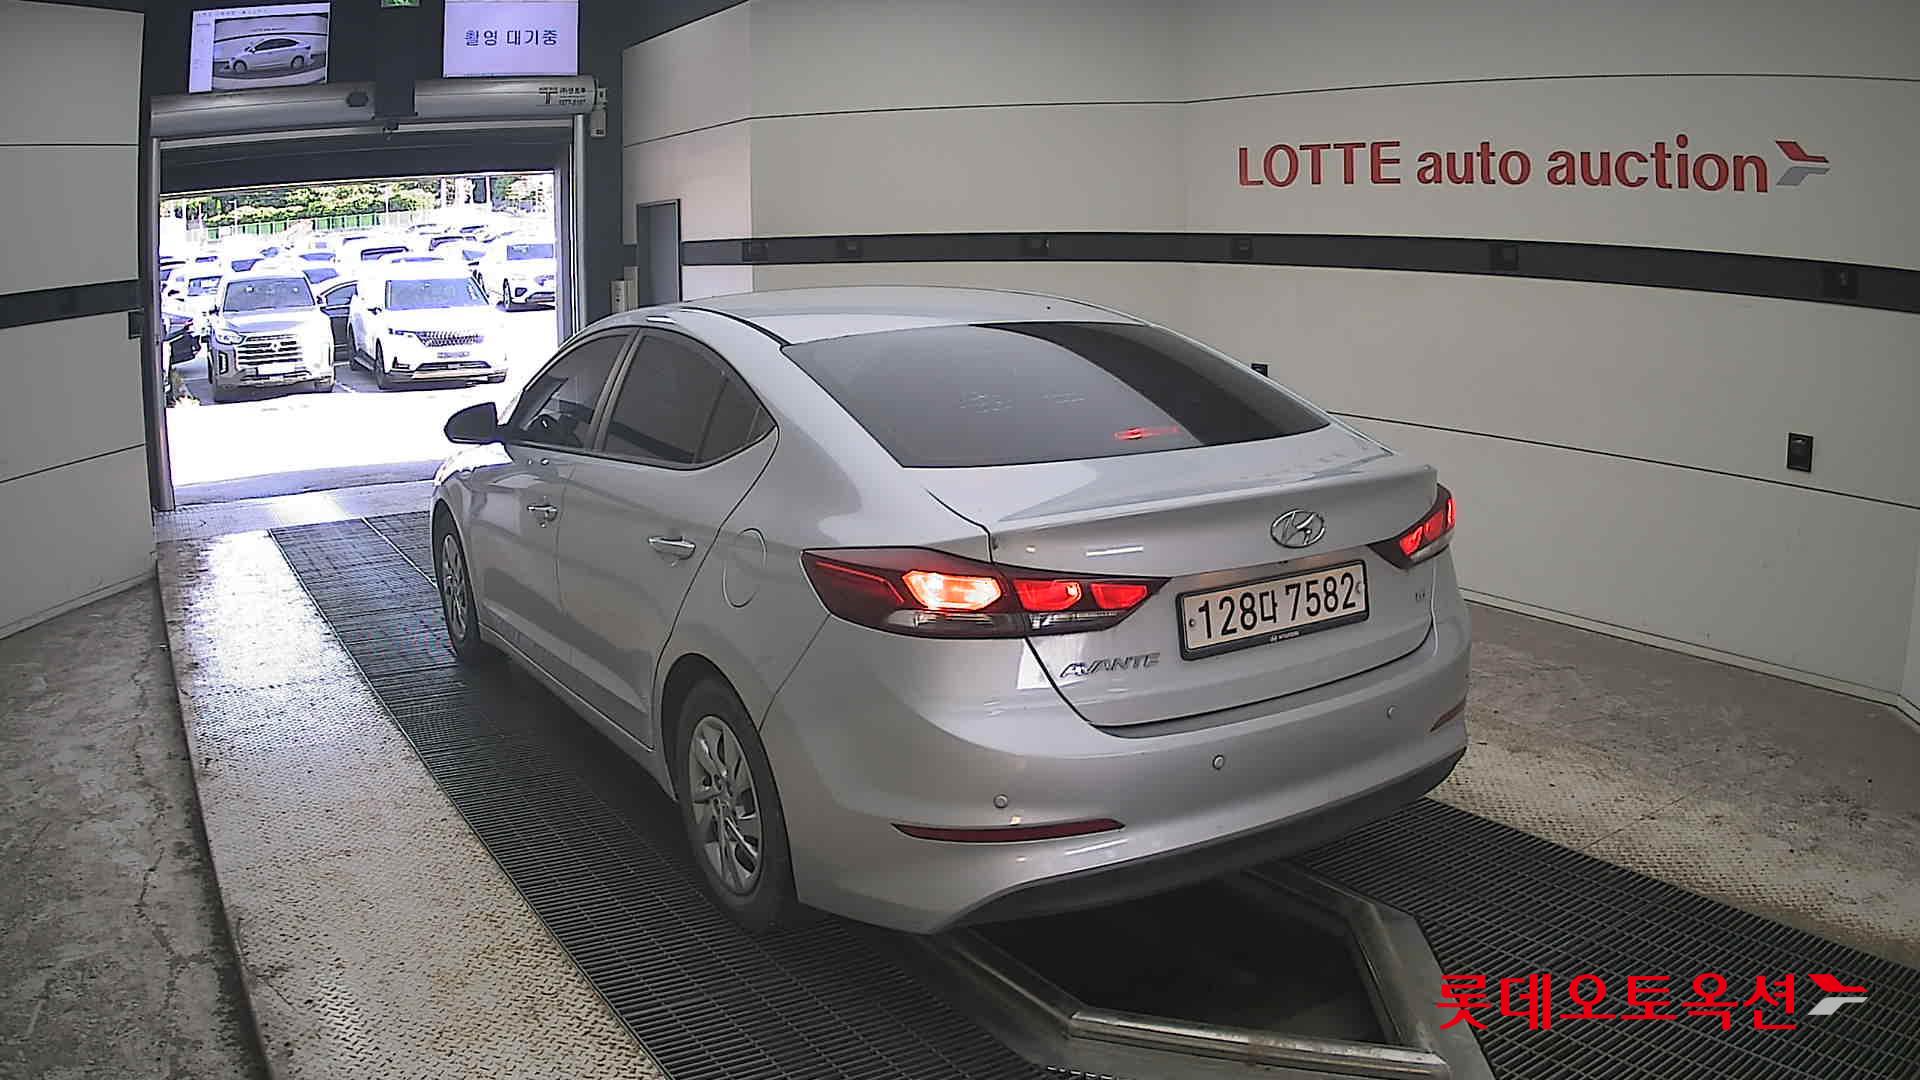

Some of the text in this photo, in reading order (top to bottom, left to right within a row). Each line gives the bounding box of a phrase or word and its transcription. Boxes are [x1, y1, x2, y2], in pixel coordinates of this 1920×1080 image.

[507, 30, 558, 46] 대기중
[1238, 133, 1769, 193] LOTTE auto auction
[1198, 572, 1356, 639] 128다 7582
[1059, 652, 1161, 677] AVANTE
